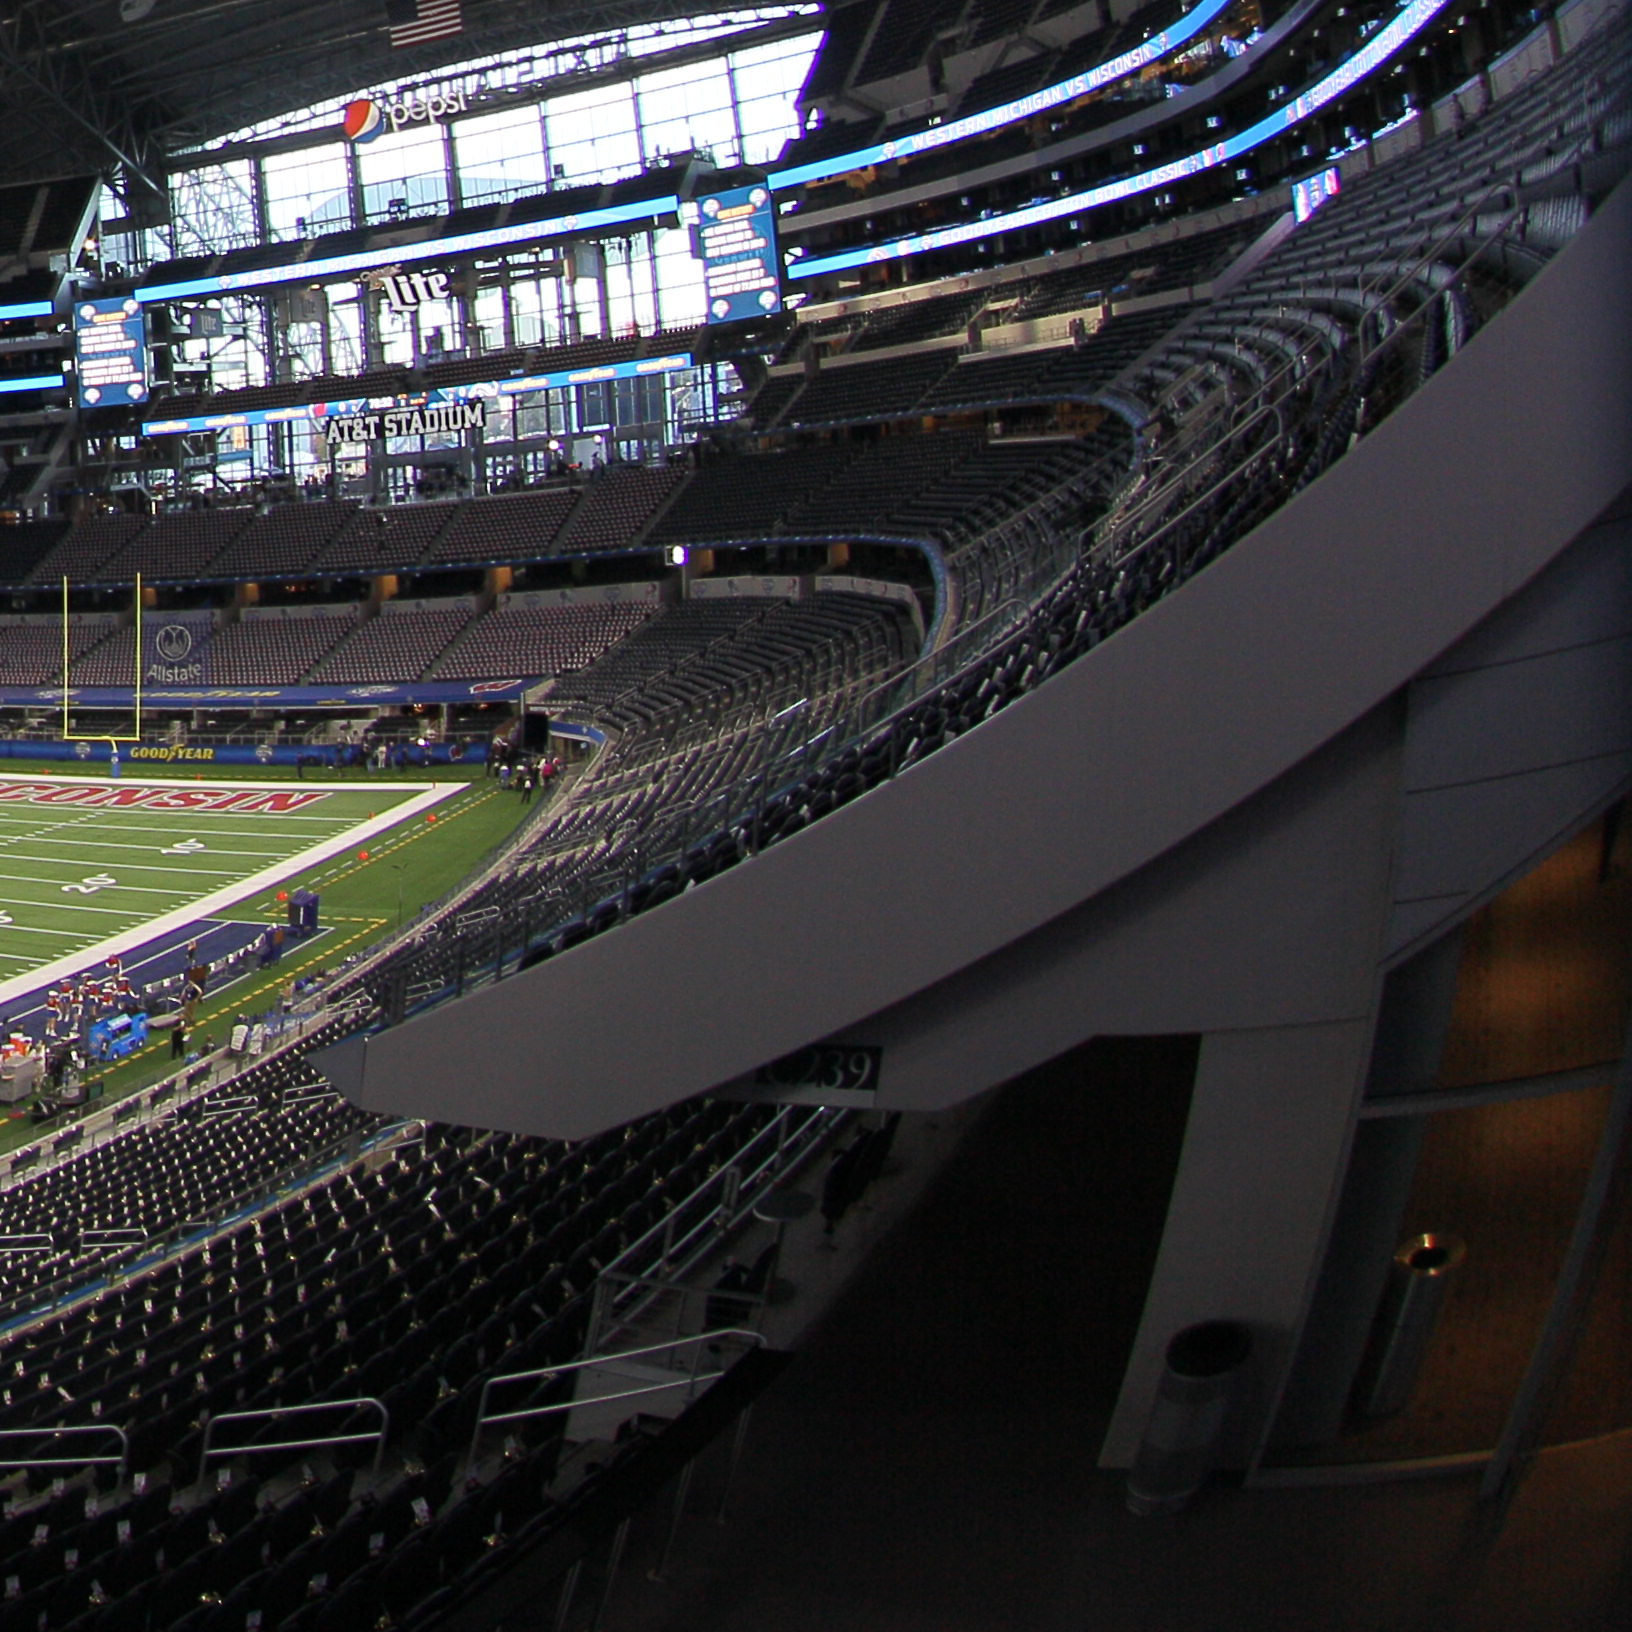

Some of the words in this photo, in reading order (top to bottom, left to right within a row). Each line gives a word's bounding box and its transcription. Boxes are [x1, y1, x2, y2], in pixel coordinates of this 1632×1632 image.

[391, 89, 468, 131] pepsi
[911, 116, 987, 151] WESTERN
[991, 85, 1064, 126] MICHIGAN
[1066, 77, 1084, 98] VS
[1088, 44, 1152, 87] WISCONSIN
[1095, 182, 1133, 206] BOWL
[1136, 162, 1188, 190] CLASSIC
[454, 220, 560, 252] WISCONSIN
[384, 268, 450, 313] Lite
[327, 415, 380, 444] AT&T
[384, 401, 484, 439] STADIUM
[146, 662, 202, 683] Allstate
[130, 744, 215, 762] GOODYEAR
[159, 839, 198, 855] 10
[60, 873, 104, 894] 20
